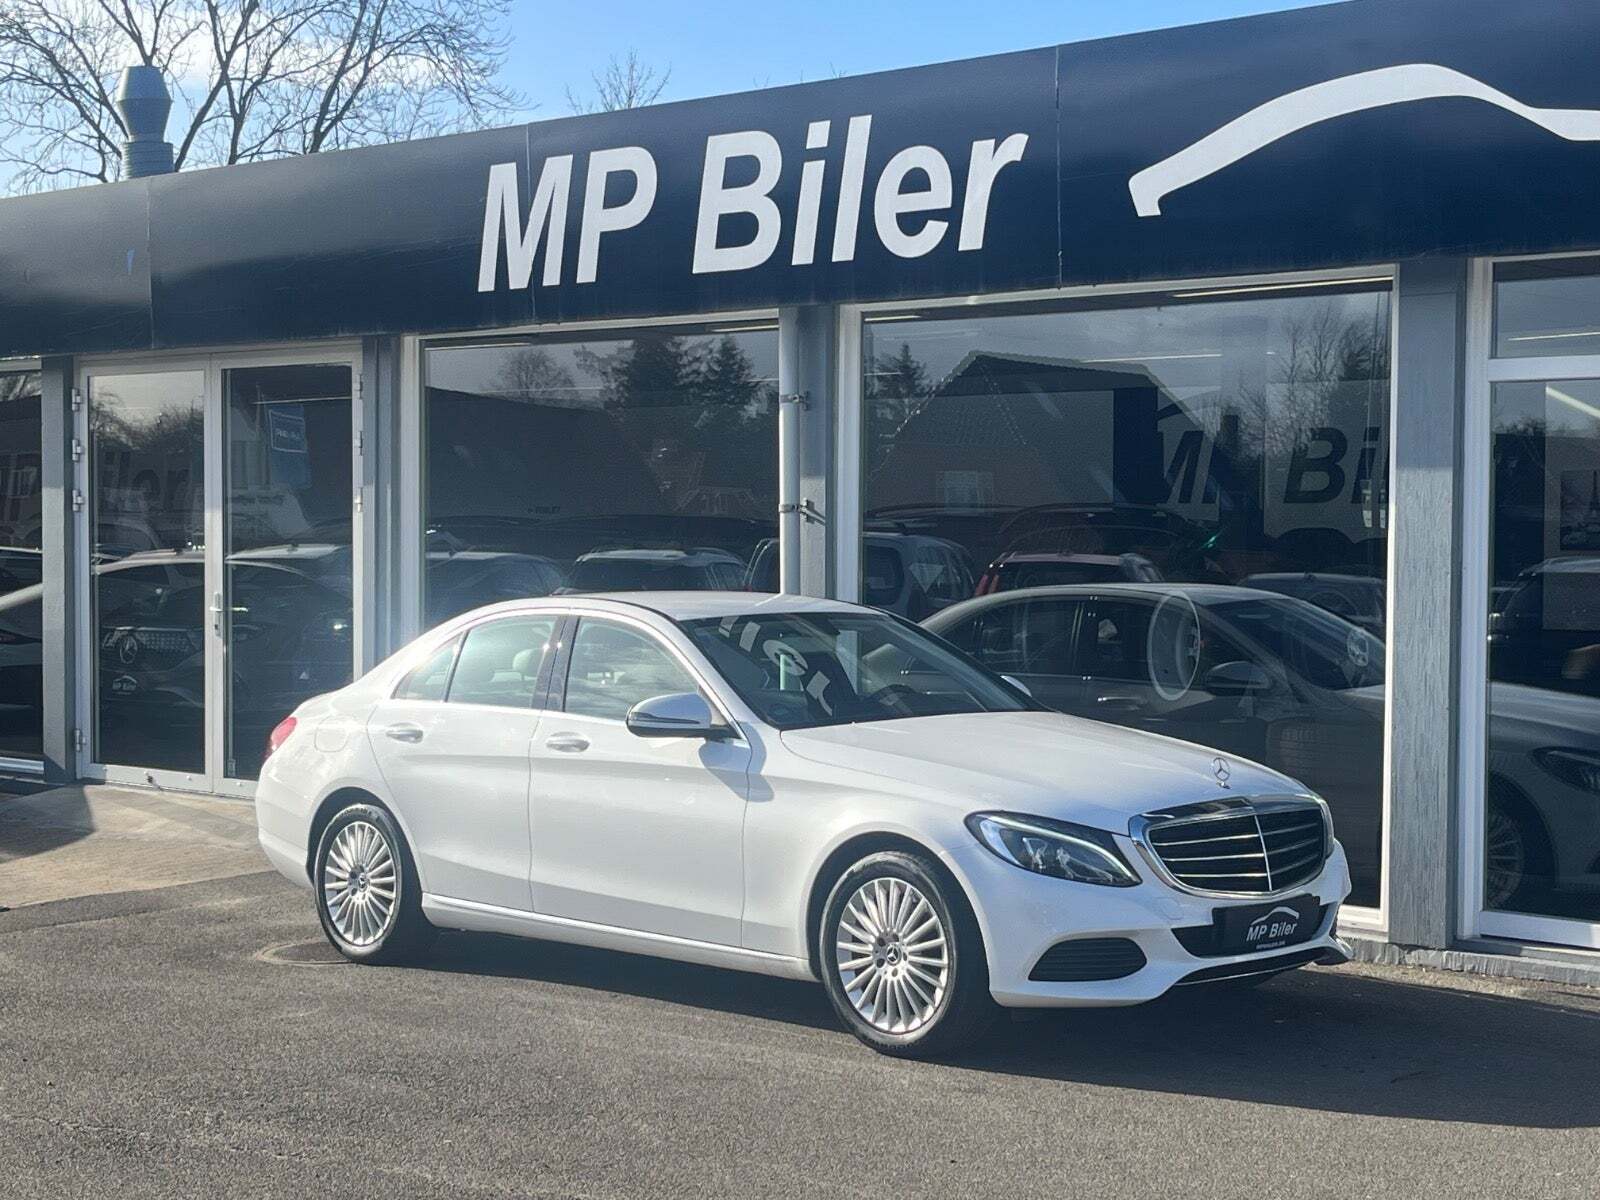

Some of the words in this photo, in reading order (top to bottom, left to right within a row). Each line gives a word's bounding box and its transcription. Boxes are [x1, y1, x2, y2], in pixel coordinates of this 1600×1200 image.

[478, 146, 657, 292] MP
[693, 114, 1029, 274] Biler
[1246, 925, 1267, 941] MP
[1269, 922, 1297, 938] Biler
